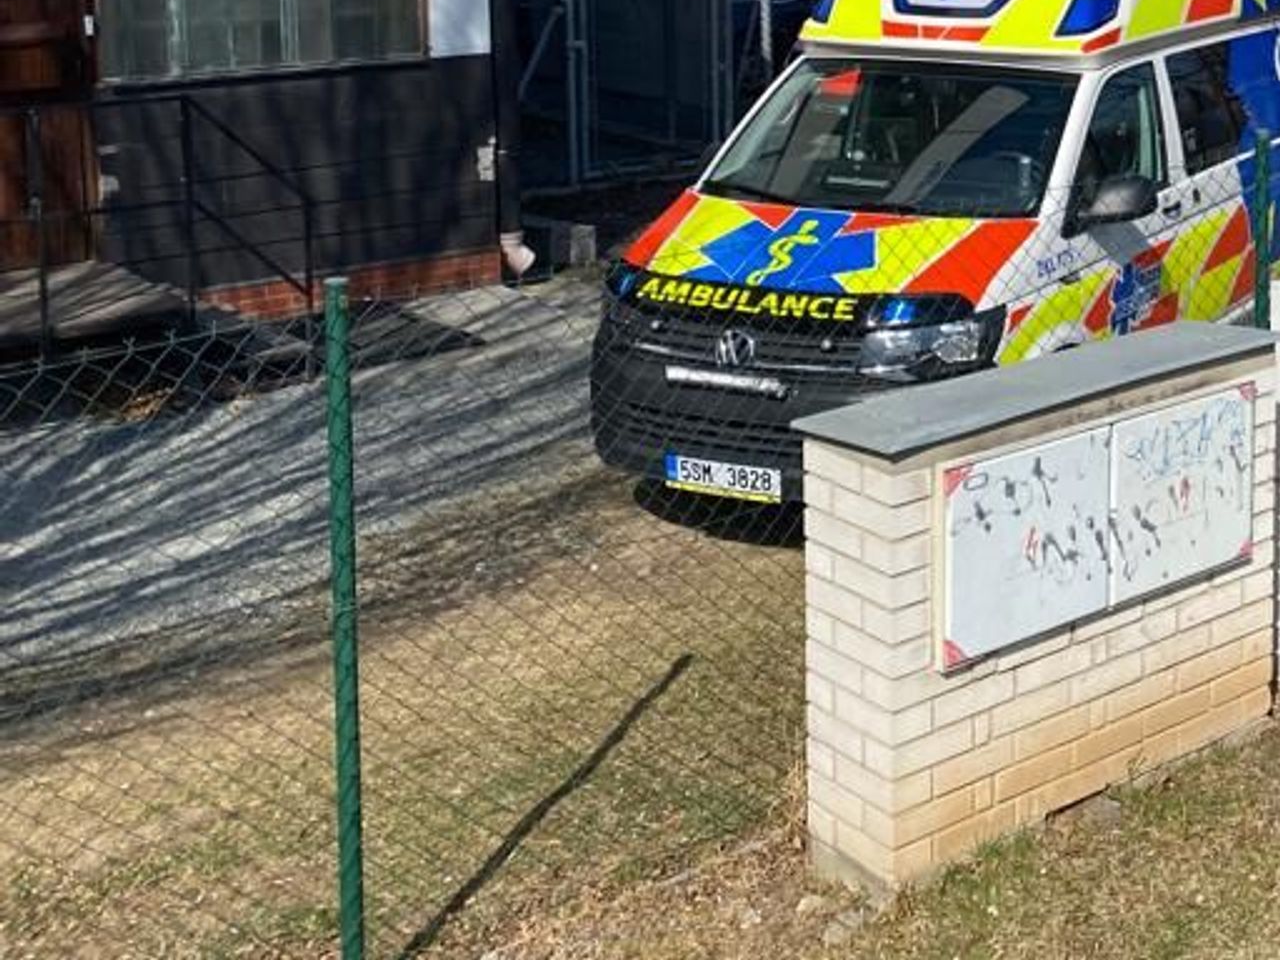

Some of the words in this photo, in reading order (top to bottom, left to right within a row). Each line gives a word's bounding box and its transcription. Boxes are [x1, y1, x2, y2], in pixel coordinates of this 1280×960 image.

[637, 278, 858, 320] AMBULANCE
[680, 459, 714, 483] 5SM
[727, 468, 772, 491] 3828
